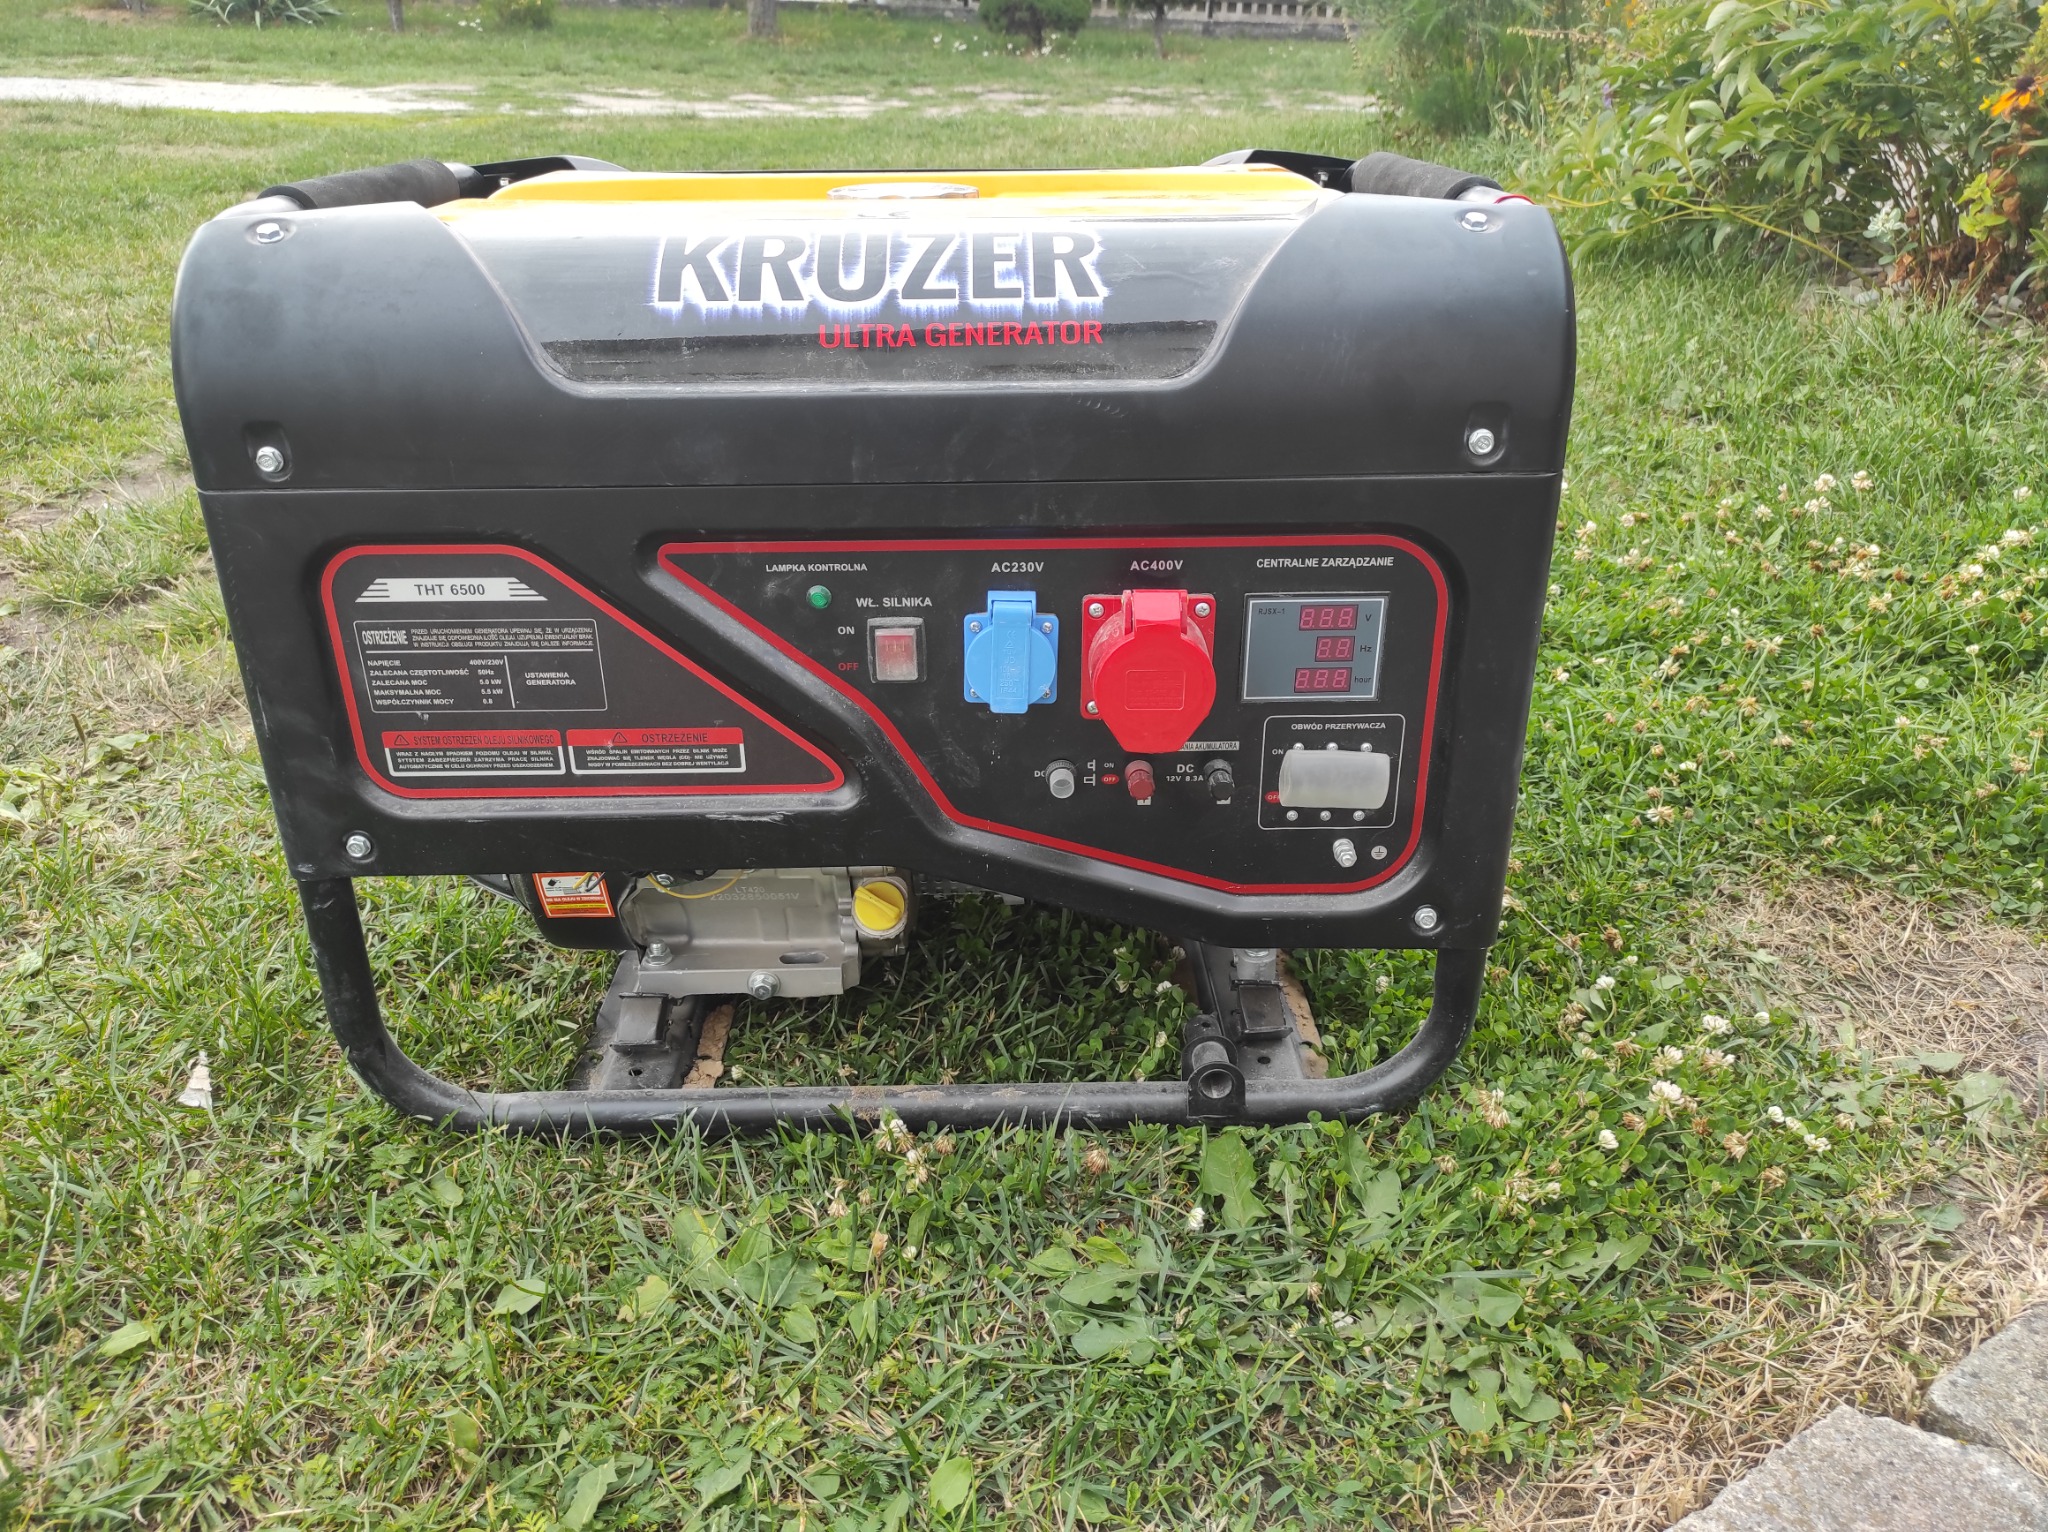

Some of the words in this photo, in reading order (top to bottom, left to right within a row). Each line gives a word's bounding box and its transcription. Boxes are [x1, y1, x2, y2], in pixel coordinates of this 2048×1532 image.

[655, 230, 1105, 304] KRUZER
[818, 322, 917, 348] ULTRA
[924, 320, 1104, 346] GENERATOR
[990, 561, 1045, 573] AC230V
[1129, 560, 1184, 571] AC400V
[1256, 558, 1320, 568] CENTRALNE
[1321, 556, 1395, 569] ZARZĄDZANIE
[765, 564, 807, 573] LAMPKA
[807, 563, 868, 572] KONTROLNA
[413, 583, 445, 596] THT
[450, 583, 486, 596] 6500
[855, 597, 879, 608] WŁ.
[882, 597, 933, 607] SILNIKA
[1258, 607, 1286, 615] RJSX-1
[1365, 614, 1372, 622] V
[837, 626, 855, 635] ON
[362, 627, 408, 645] OSTRZEŻENIE
[1360, 645, 1372, 653] Hz
[409, 668, 470, 677] CZĘSTOTLIWOŚĆ
[838, 663, 860, 672] OFF
[1354, 676, 1372, 684] hour
[375, 698, 432, 706] WSPÓŁCZYNNIK
[1291, 722, 1323, 730] OBWÓD
[1325, 722, 1387, 730] PRZERYWACZA
[413, 735, 440, 745] SYSTEM
[483, 734, 506, 745] OLEJU
[507, 734, 555, 745] SILNIKOWEGO
[1195, 741, 1238, 750] AKUMULATORA
[1176, 763, 1195, 773] DC
